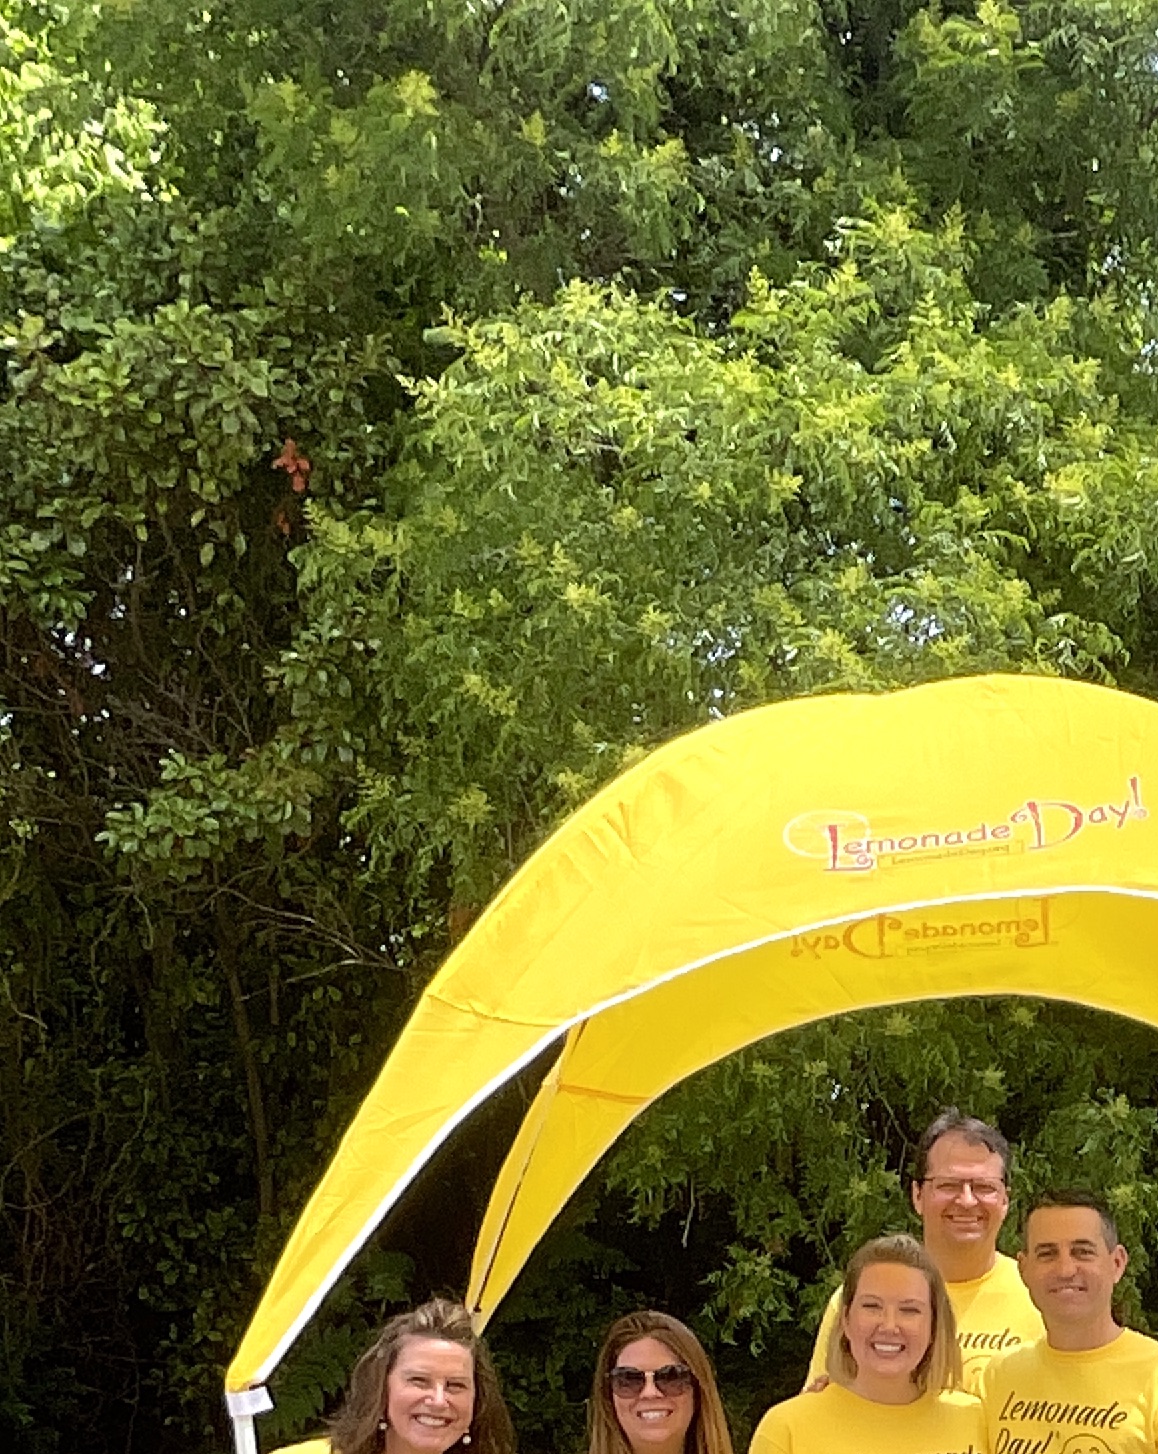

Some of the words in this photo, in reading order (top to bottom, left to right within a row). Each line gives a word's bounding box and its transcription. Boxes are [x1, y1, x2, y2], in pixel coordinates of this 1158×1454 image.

[820, 823, 1012, 872] Lemonade
[1010, 775, 1148, 850] Day!
[999, 1391, 1127, 1429] Lemonade
